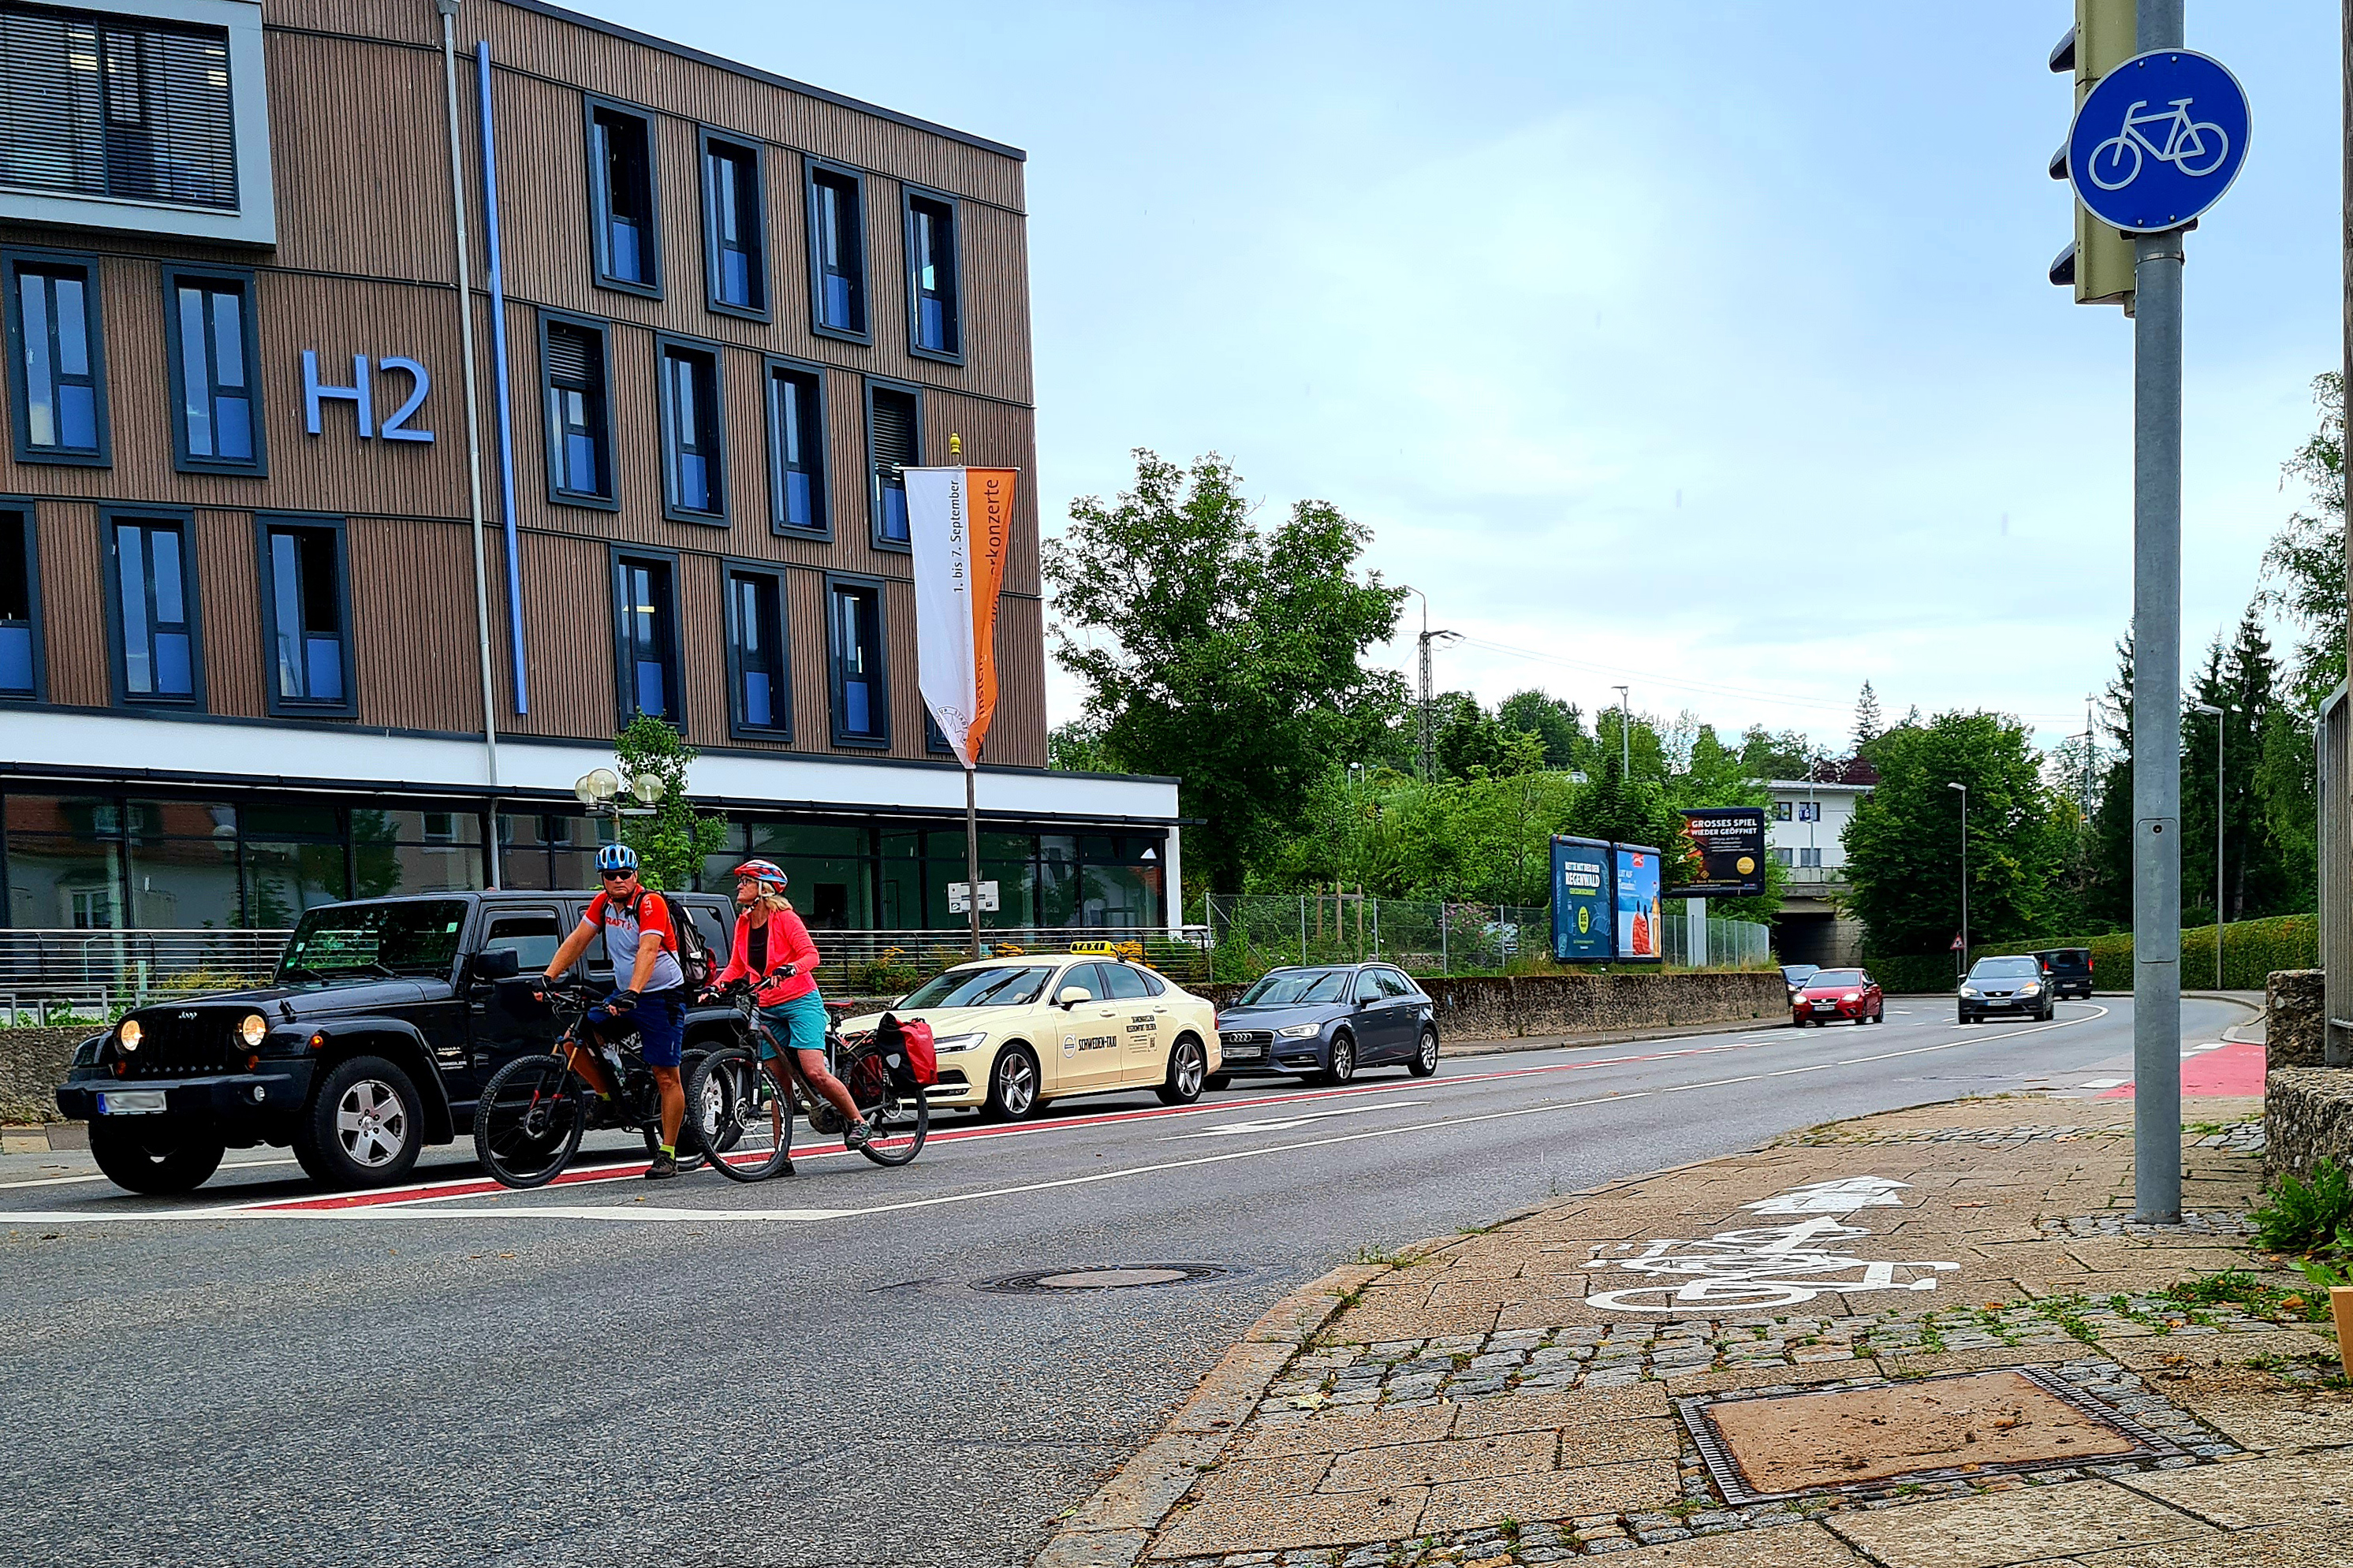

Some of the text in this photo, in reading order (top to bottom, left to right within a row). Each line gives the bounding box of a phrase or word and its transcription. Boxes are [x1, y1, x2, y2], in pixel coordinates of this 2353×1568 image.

[303, 350, 434, 442] H2
[949, 479, 964, 543] September
[952, 546, 962, 557] 7.
[983, 479, 1001, 622] rkonzerte
[952, 562, 964, 579] bis
[1691, 819, 1732, 829] GROSSES
[1720, 827, 1758, 836] GEÖFFNET
[606, 917, 626, 928] RAFT
[1078, 1035, 1118, 1052] SCHWEDEN-TAXI
